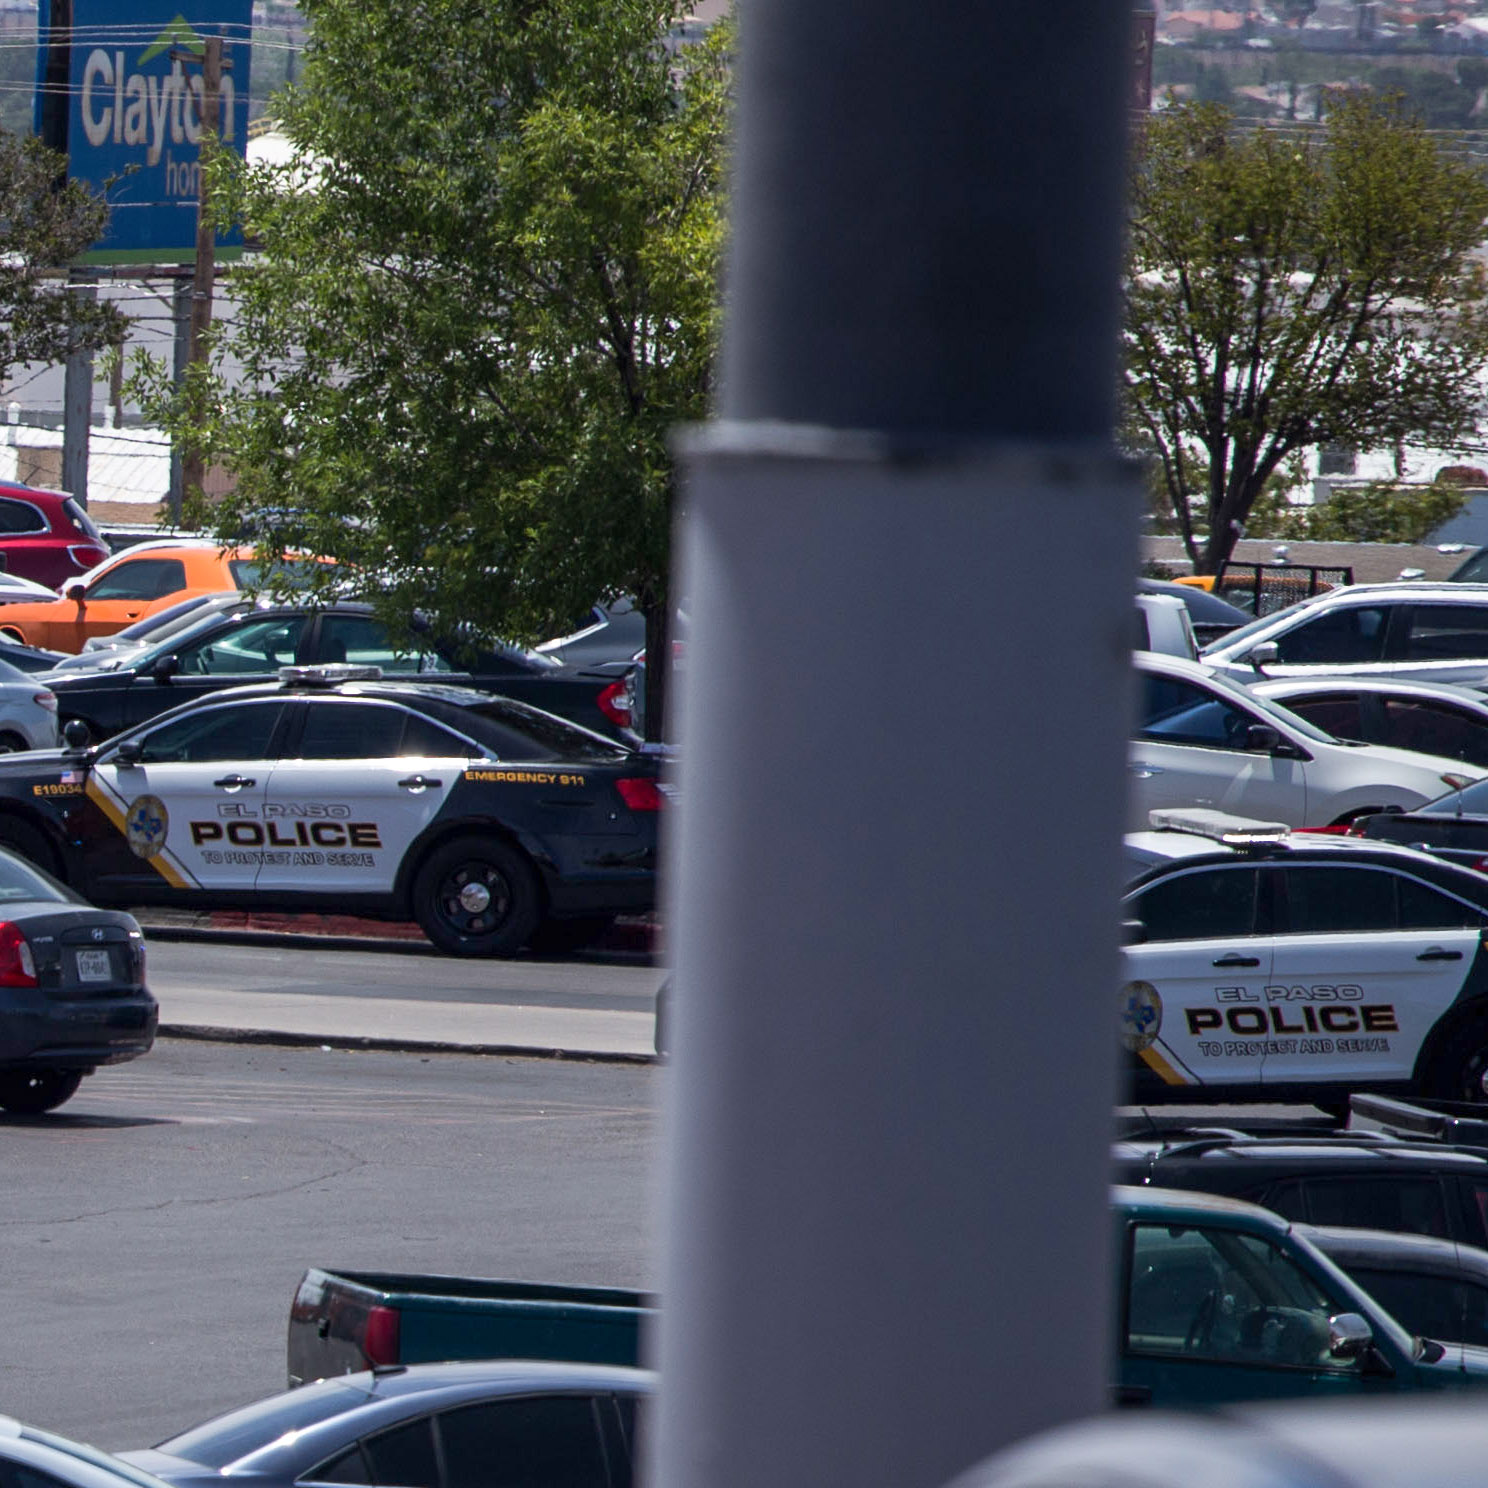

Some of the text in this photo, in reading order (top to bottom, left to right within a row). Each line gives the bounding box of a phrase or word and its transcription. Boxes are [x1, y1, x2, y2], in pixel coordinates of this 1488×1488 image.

[81, 48, 235, 167] Clayton
[465, 771, 585, 786] EMERGENCY 911
[33, 784, 82, 796] E19034
[217, 803, 351, 819] EL PASO
[189, 821, 383, 848] POLICE
[201, 852, 375, 867] TO PROTECT AND SERVE
[1215, 984, 1365, 1003] EL PASO
[1184, 1004, 1400, 1036] POLICE
[1198, 1038, 1390, 1057] TO PROTECT AND SERVE
